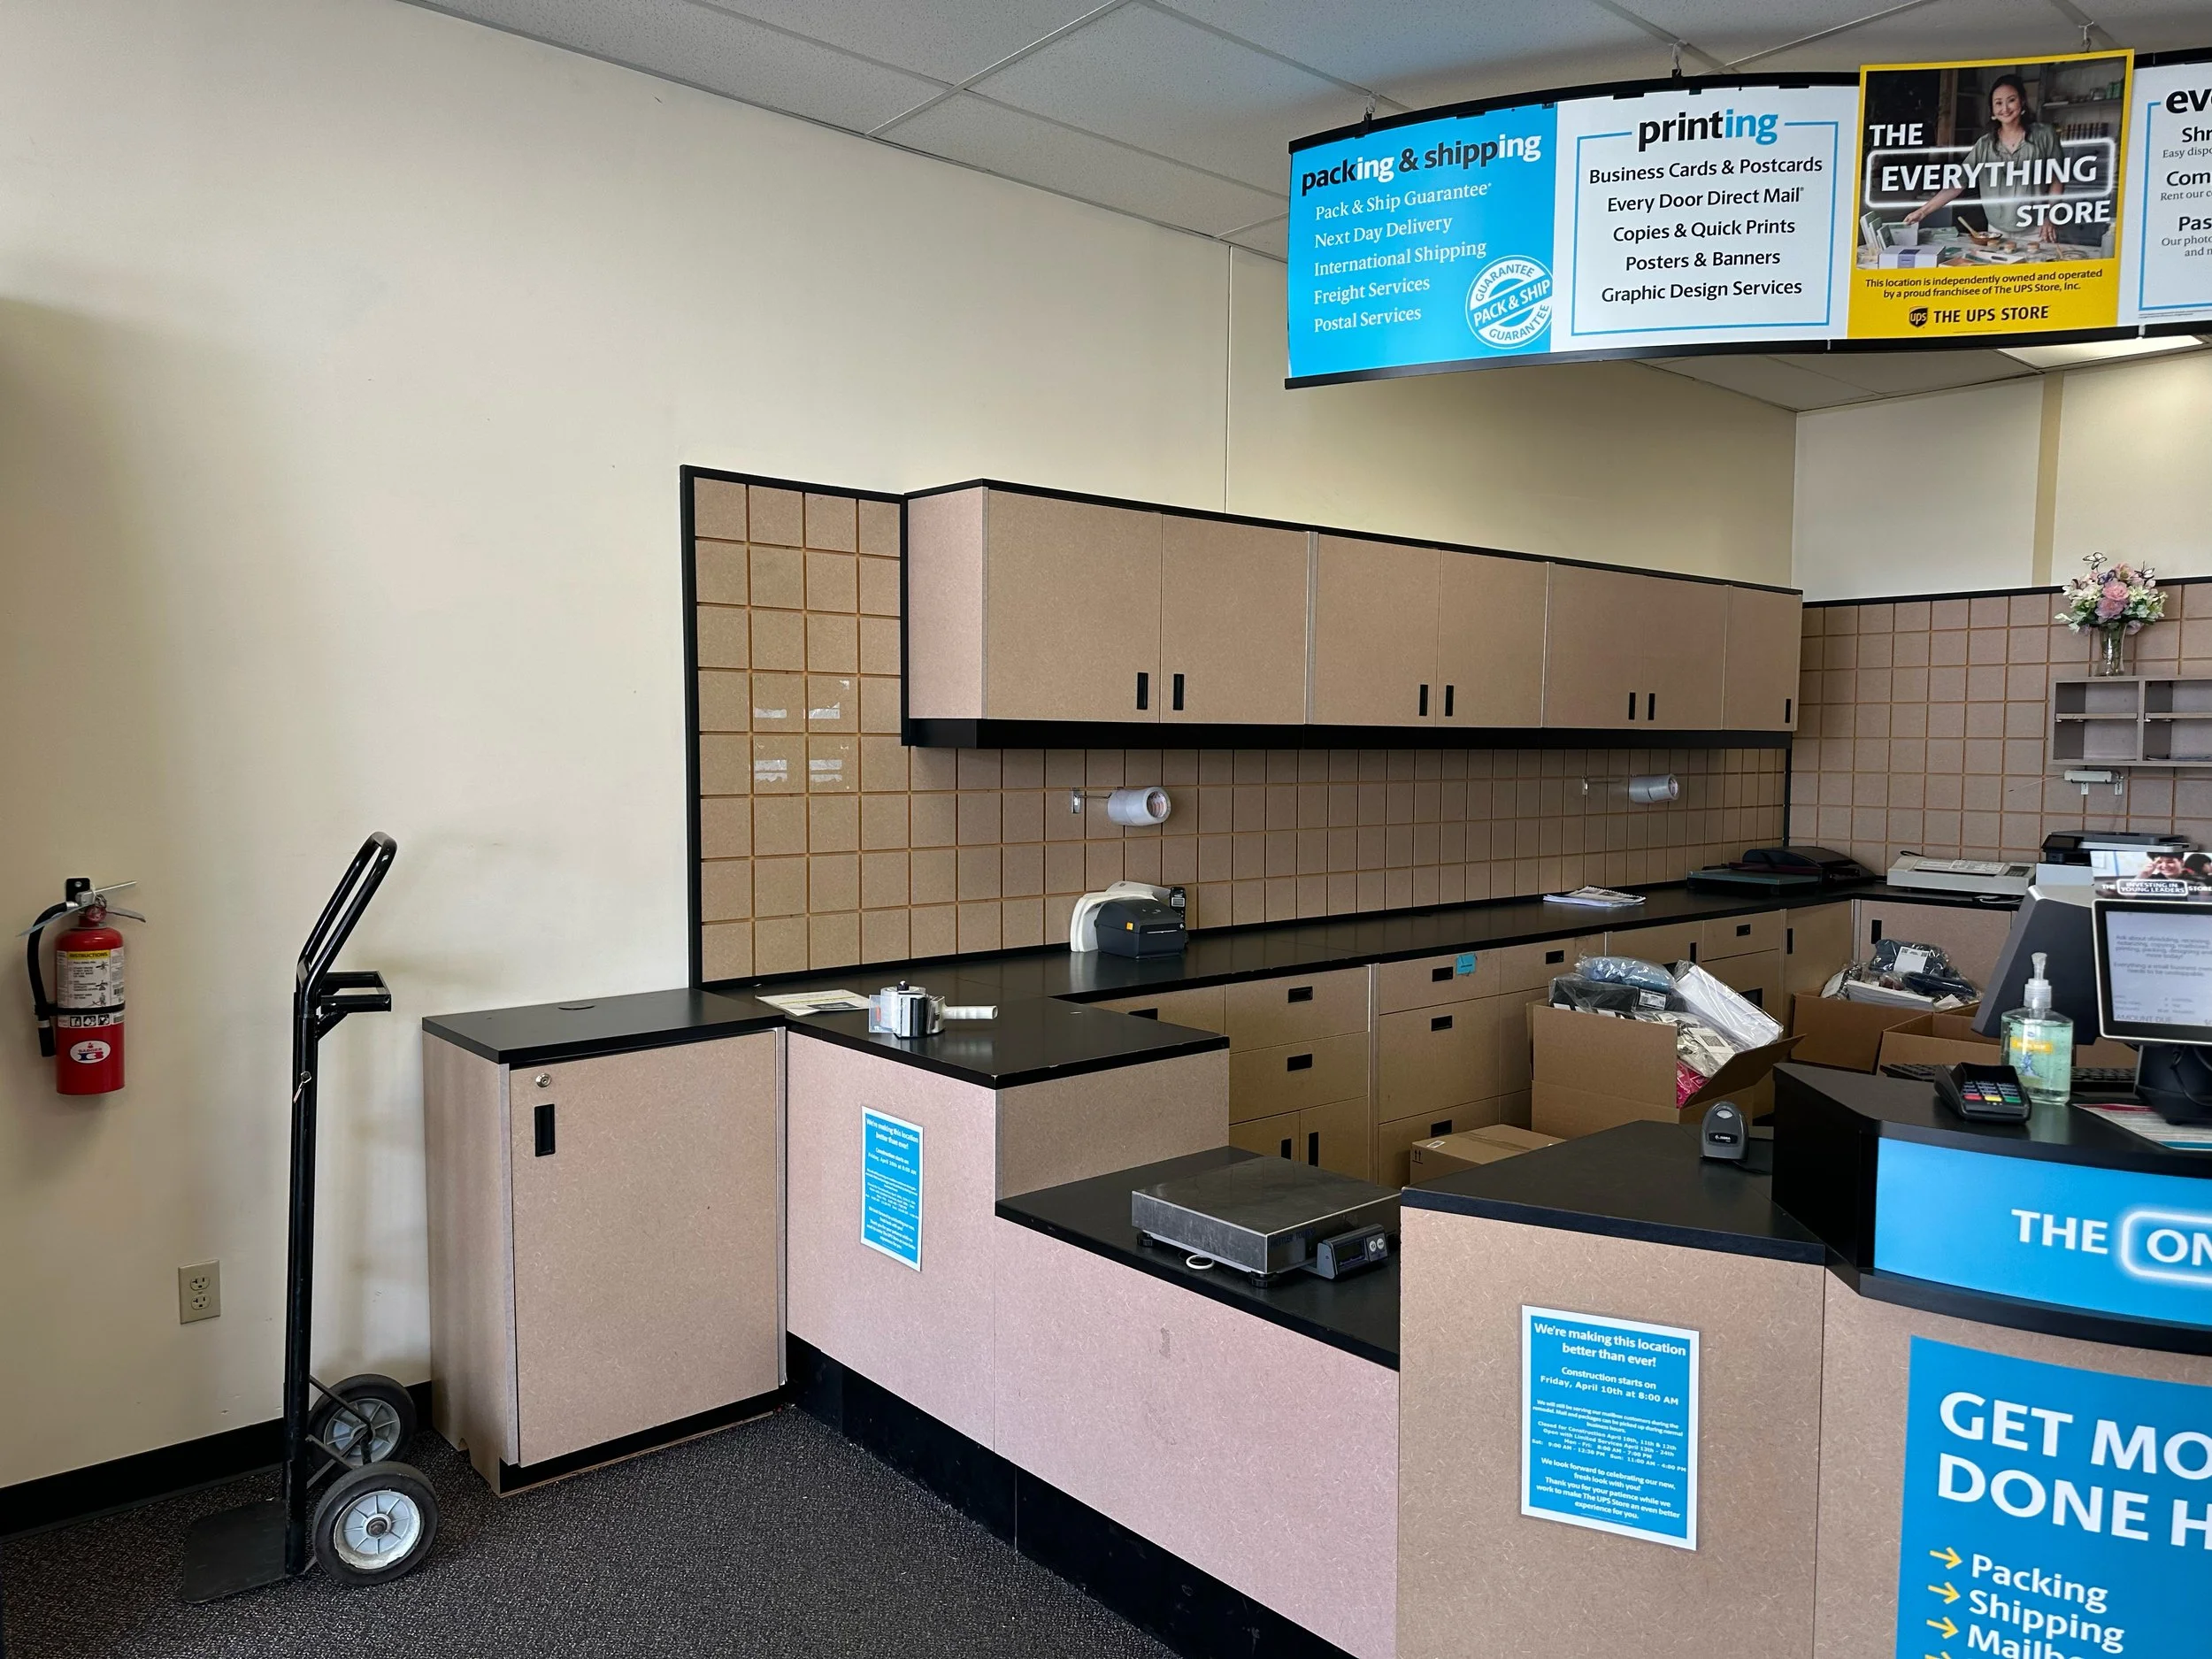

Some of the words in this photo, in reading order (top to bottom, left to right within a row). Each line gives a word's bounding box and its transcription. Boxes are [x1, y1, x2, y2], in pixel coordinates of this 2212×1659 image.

[2166, 89, 2212, 113] ev
[1639, 109, 1778, 152] printing
[1869, 123, 1924, 146] THE
[1302, 157, 1394, 196] packing
[1399, 148, 1418, 172] &
[1425, 134, 1541, 169] shipping
[2162, 150, 2185, 158] Easy
[1589, 167, 1663, 184] Business
[1670, 161, 1717, 177] Cards
[1722, 159, 1734, 174] &
[1740, 157, 1823, 173] Postcards
[1881, 156, 2097, 192] EVERYTHING
[2167, 171, 2210, 186] Com
[1316, 203, 1348, 220] Pack
[1352, 199, 1363, 214] &
[1367, 195, 1400, 212] Ship
[1608, 197, 1655, 213] Every
[1660, 193, 1703, 208] Door
[1708, 189, 1759, 205] Direct
[2161, 192, 2184, 201] Rent
[2016, 200, 2110, 227] STORE
[1315, 230, 1350, 248] Next
[1354, 227, 1382, 242] Day
[1386, 218, 1452, 237] Delivery
[1613, 226, 1670, 244] Copies
[1674, 224, 1686, 238] &
[1692, 220, 1741, 238] Quick
[1747, 219, 1795, 234] Prints
[2162, 237, 2182, 246] Our
[1314, 249, 1410, 276] International
[1416, 242, 1486, 263] Shipping
[1626, 255, 1688, 271] Posters
[1694, 253, 1706, 266] &
[1713, 251, 1780, 266] Banners
[2185, 248, 2204, 257] and
[1314, 286, 1364, 304] Freight
[1369, 278, 1430, 297] Services
[1476, 265, 1534, 302] GUARANTEE
[1601, 285, 1665, 303] Graphic
[1670, 283, 1727, 300] Design
[1732, 280, 1802, 296] Services
[1866, 279, 1883, 288] This
[1886, 277, 1922, 287] location
[1924, 277, 1931, 286] is
[1932, 274, 2000, 287] independently
[2003, 273, 2035, 283] owned
[2037, 272, 2056, 281] and
[2058, 269, 2102, 281] operated
[1884, 288, 1894, 299] by
[1904, 288, 1931, 299] proud
[1932, 287, 1980, 296] franchisee
[1982, 286, 1993, 295] of
[2035, 283, 2062, 294] Store,
[1473, 300, 1506, 326] PACK
[1509, 296, 1519, 310] &
[1521, 279, 1549, 303] SHIP
[1910, 311, 1927, 324] ups
[1934, 311, 1960, 323] THE
[1966, 309, 1995, 322] UPS
[2001, 306, 2049, 320] STORE
[1314, 313, 1357, 332] Postal
[1361, 308, 1421, 325] Services
[1489, 304, 1549, 341] GUARANTEE
[2011, 1209, 2109, 1255] THE
[1534, 1323, 1566, 1337] We're
[1568, 1331, 1612, 1347] making
[1614, 1336, 1635, 1348] this
[1638, 1339, 1686, 1356] location
[1562, 1342, 1597, 1358] better
[1598, 1348, 1625, 1363] than
[1627, 1355, 1656, 1367] ever!
[1562, 1366, 1617, 1383] Construction
[1617, 1377, 1643, 1387] starts
[1540, 1375, 1572, 1388] Friday,
[1575, 1381, 1598, 1392] April
[1601, 1386, 1623, 1395] 10th
[1638, 1392, 1661, 1402] 8:00
[1663, 1396, 1679, 1405] AM
[1568, 1426, 1606, 1438] Construction
[1939, 1390, 2074, 1458] GET
[2090, 1418, 2212, 1481] MO
[1554, 1459, 1569, 1469] look
[1570, 1463, 1597, 1474] forward
[1606, 1471, 1644, 1485] celebrating
[1573, 1471, 1591, 1482] fresh
[1592, 1476, 1608, 1485] look
[1609, 1479, 1624, 1488] with
[1625, 1483, 1641, 1492] you!
[1536, 1484, 1555, 1493] work
[1563, 1489, 1583, 1499] make
[1596, 1495, 1610, 1505] UPS
[1611, 1498, 1631, 1509] Store
[1658, 1508, 1681, 1518] better
[1545, 1476, 1567, 1486] Thank
[1609, 1490, 1639, 1502] patience
[1640, 1496, 1660, 1505] while
[1937, 1451, 2150, 1542] DONE
[1574, 1501, 1612, 1514] experience
[1971, 1553, 2108, 1614] Packing
[1968, 1589, 2125, 1655] Shipping
[1967, 1624, 2086, 1659] Mailb
